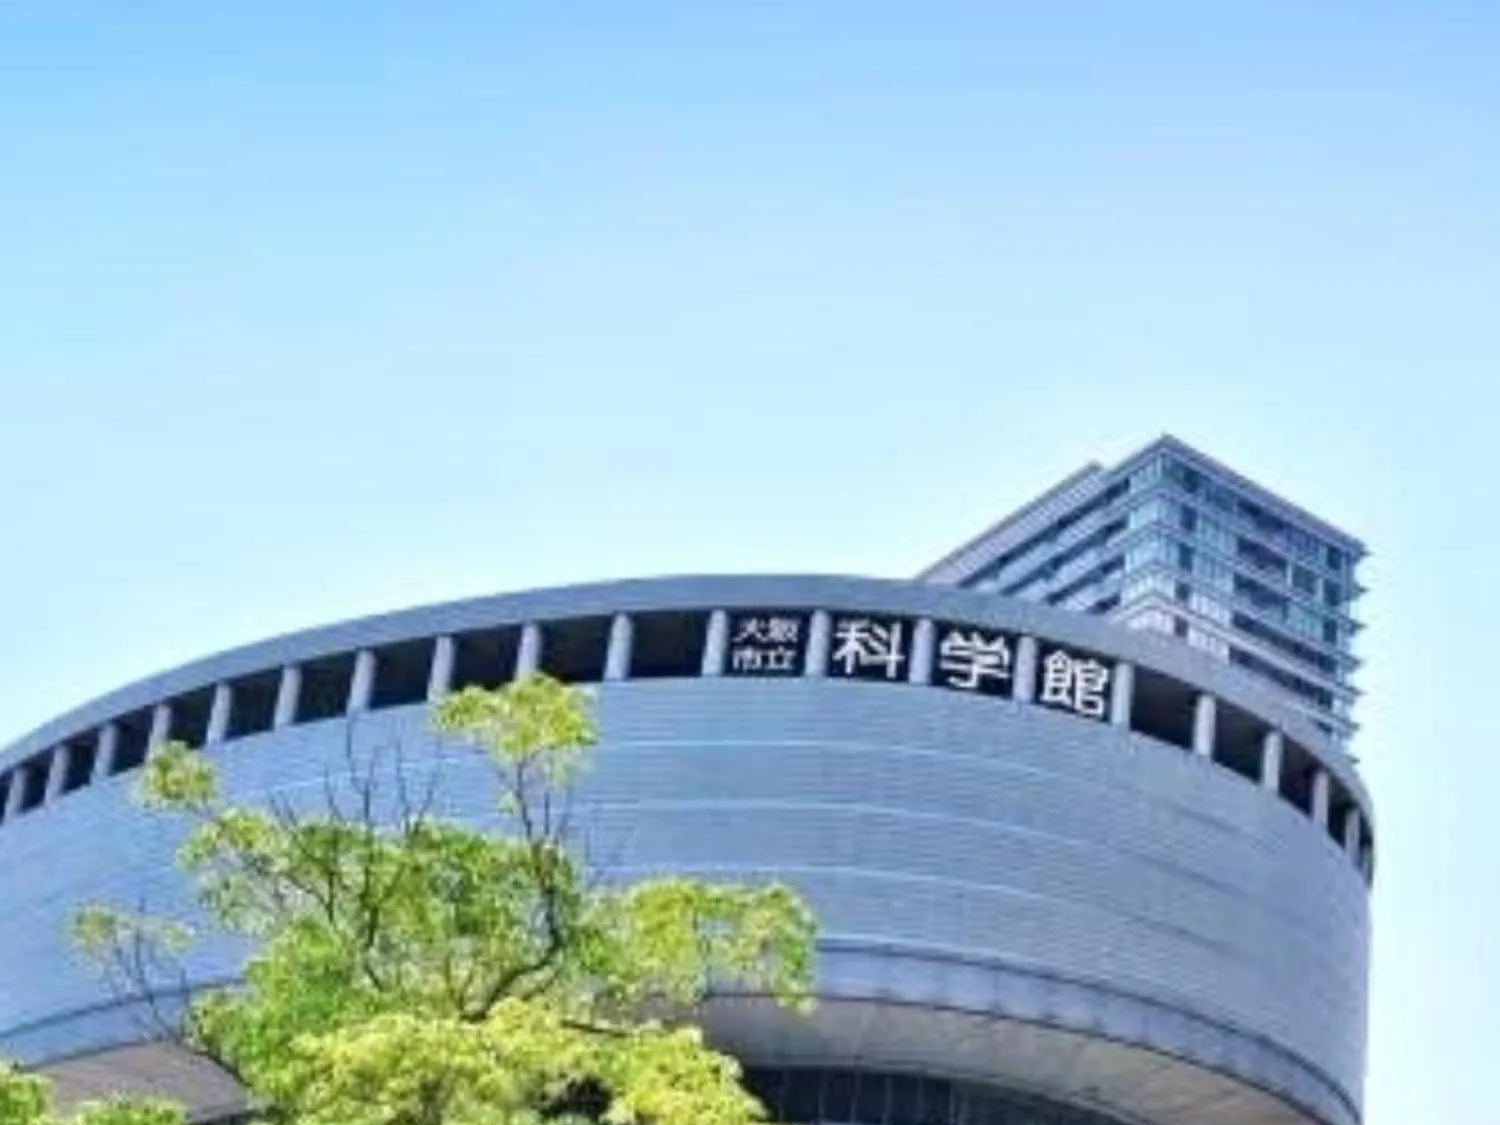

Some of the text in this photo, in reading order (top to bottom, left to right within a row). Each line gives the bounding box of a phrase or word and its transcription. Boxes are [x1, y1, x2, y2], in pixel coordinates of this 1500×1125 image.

[732, 646, 796, 671] 市立
[832, 619, 1109, 716] 科学館
